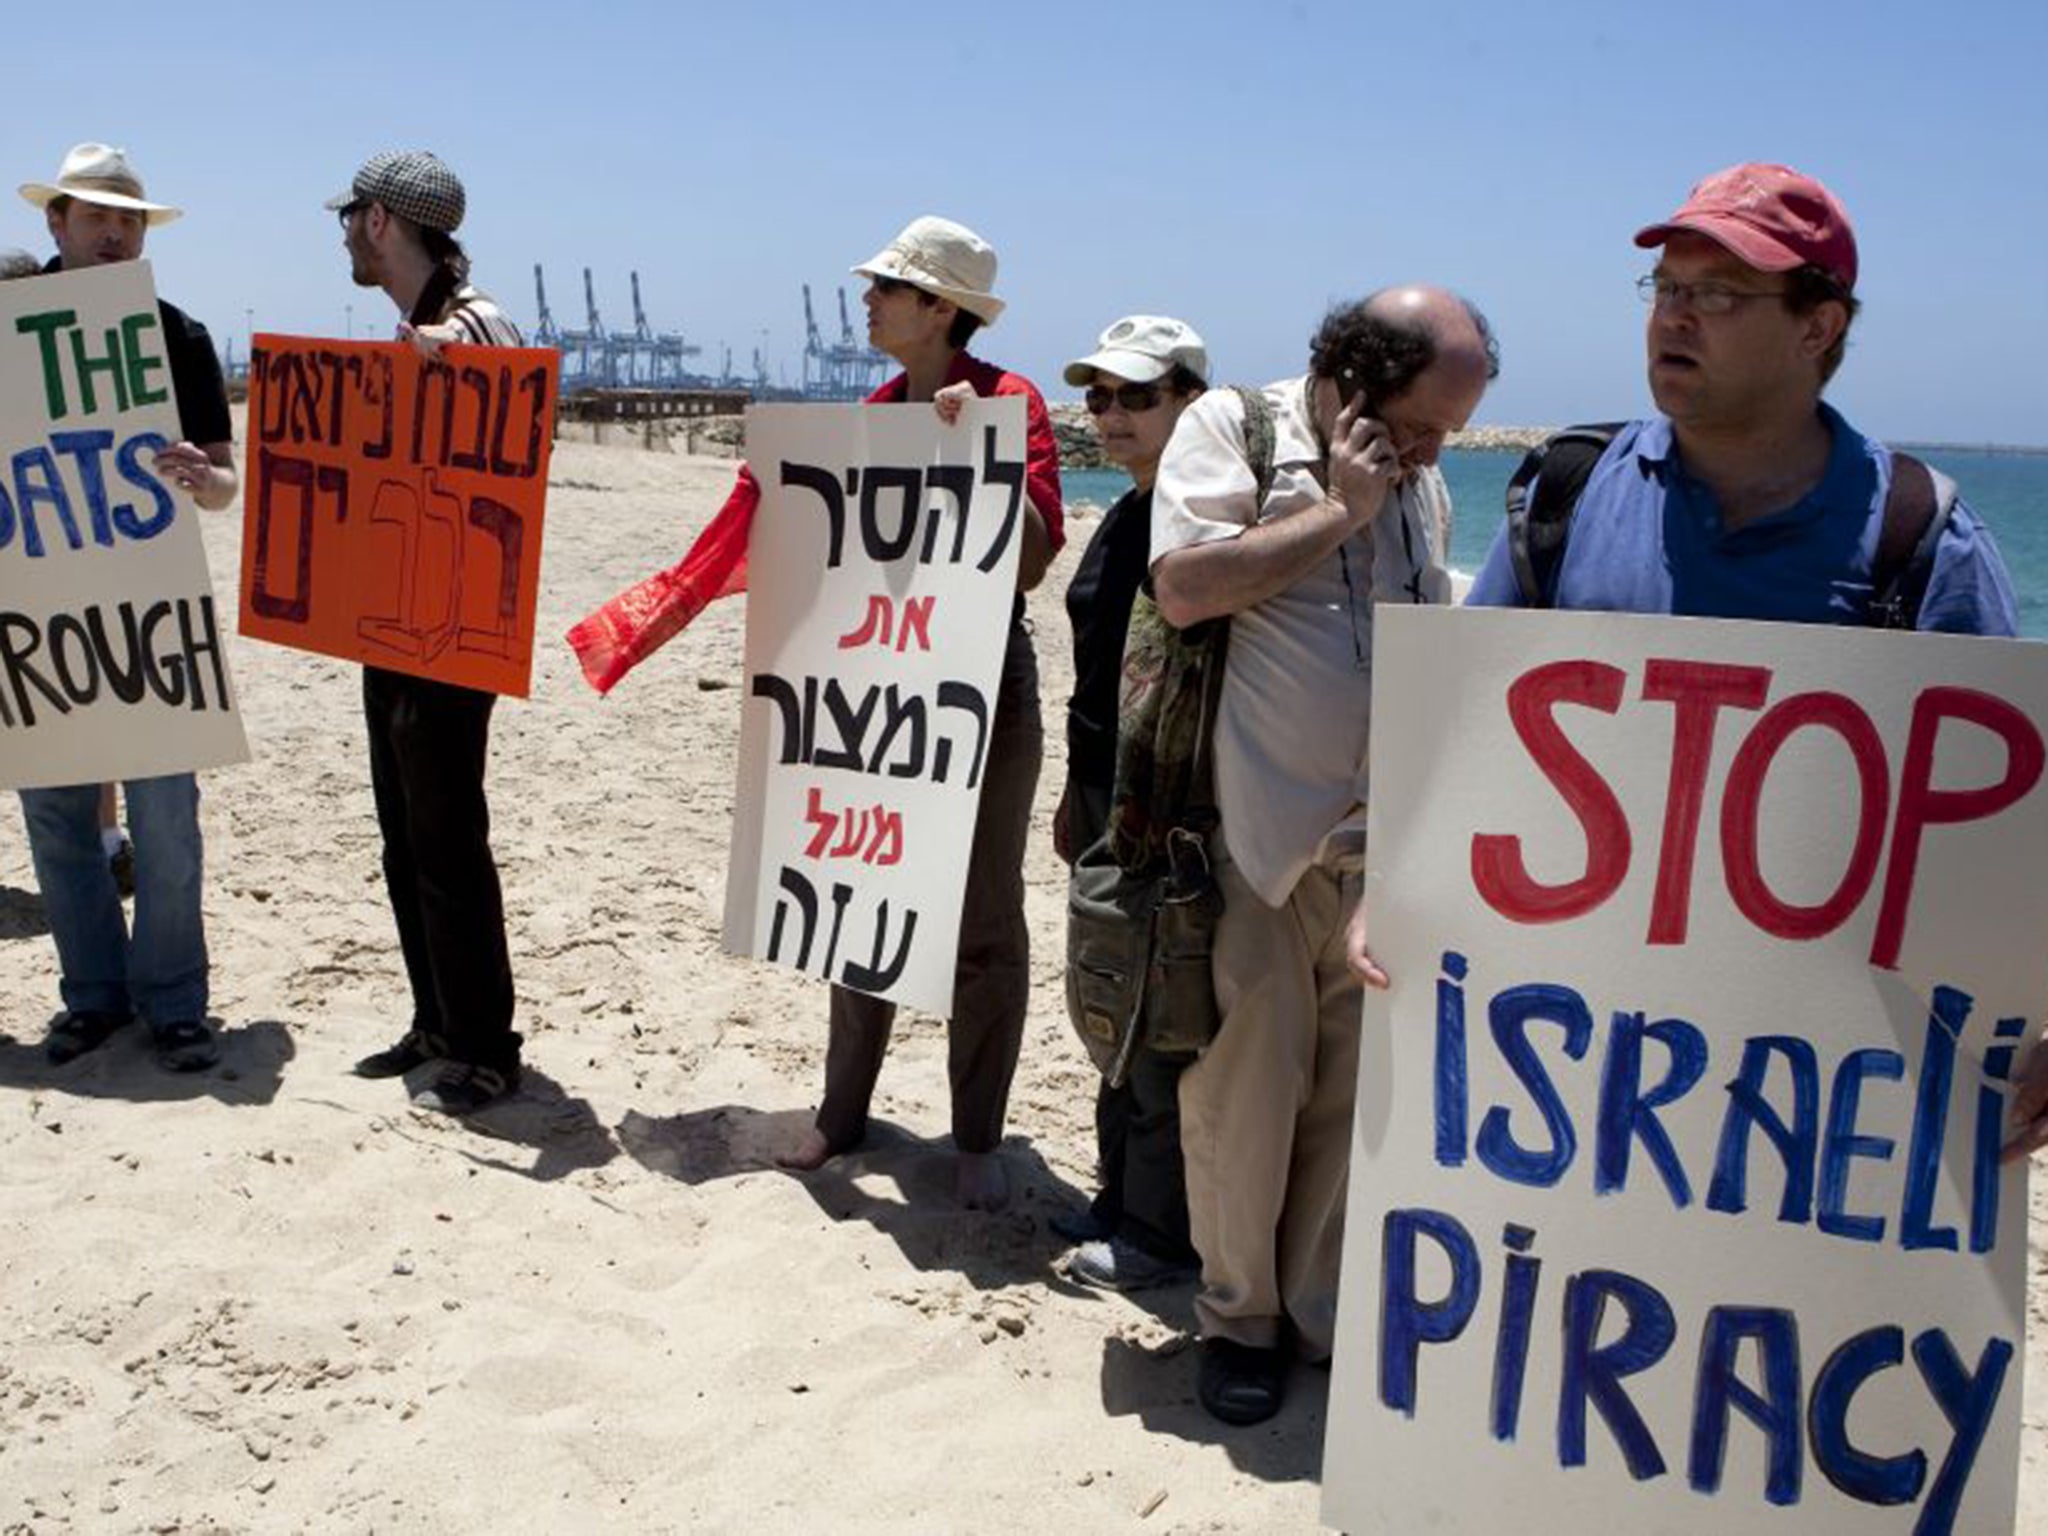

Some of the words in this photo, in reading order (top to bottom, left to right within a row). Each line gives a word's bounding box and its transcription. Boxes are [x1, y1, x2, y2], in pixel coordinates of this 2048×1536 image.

[16, 309, 168, 420] THE
[780, 424, 1024, 574] להסיר
[0, 595, 229, 728] ROUGH
[837, 595, 935, 652] את
[752, 673, 988, 790] המצור
[804, 787, 904, 866] מעל
[1471, 659, 2045, 970] STOP
[767, 865, 918, 992] עזה
